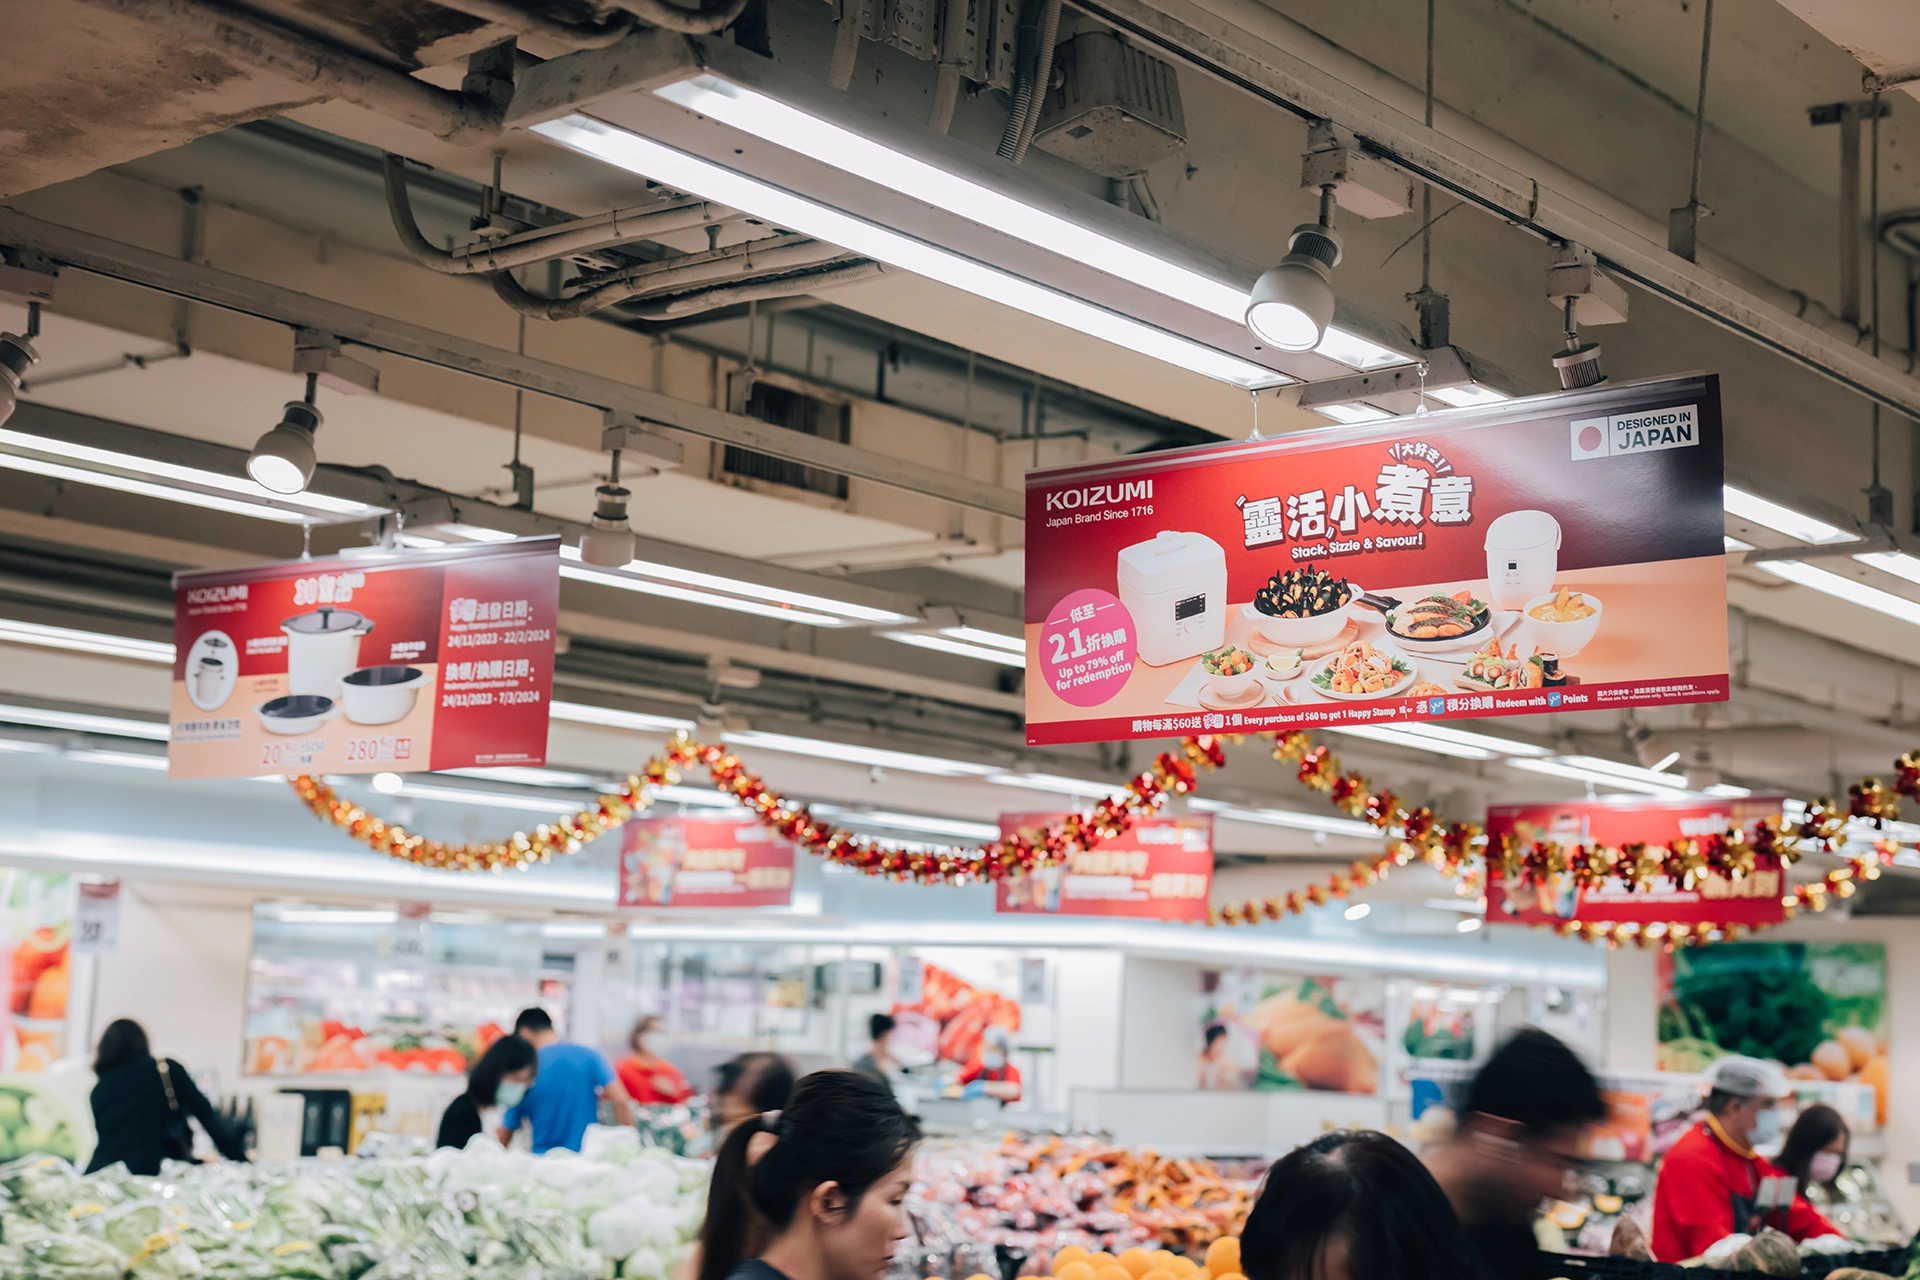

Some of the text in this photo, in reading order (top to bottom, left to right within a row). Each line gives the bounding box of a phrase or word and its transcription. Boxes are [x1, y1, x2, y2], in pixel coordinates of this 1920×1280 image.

[1617, 411, 1691, 431] DESIGNED IN
[1618, 424, 1692, 450] JAPAN
[1046, 479, 1153, 511] KOIZUMI
[1046, 505, 1154, 528] Japan Brand Since 1716
[1291, 531, 1424, 559] Stack, Sizzle & Savour!
[187, 584, 249, 604] KOIZUMI
[1070, 603, 1096, 624] 低至
[447, 632, 498, 649] 24/11/2023
[504, 629, 551, 645] 22/2/2024
[1058, 650, 1124, 679] Up to 79% off
[1056, 662, 1132, 691] for redemption
[442, 692, 493, 708] 24/11/2023
[499, 691, 540, 706] 7/3/2024
[1244, 716, 1262, 726] Every
[1264, 713, 1296, 725] purchase
[1296, 712, 1305, 721] of
[1305, 711, 1319, 721] $60
[1320, 711, 1328, 720] to
[1329, 711, 1342, 721] get
[1342, 709, 1347, 718] 1
[1348, 708, 1372, 719] Happy
[1373, 707, 1396, 717] Stamp
[1496, 698, 1528, 709] Redeem
[1528, 696, 1546, 706] with
[1563, 693, 1588, 704] Points
[347, 739, 378, 760] 280
